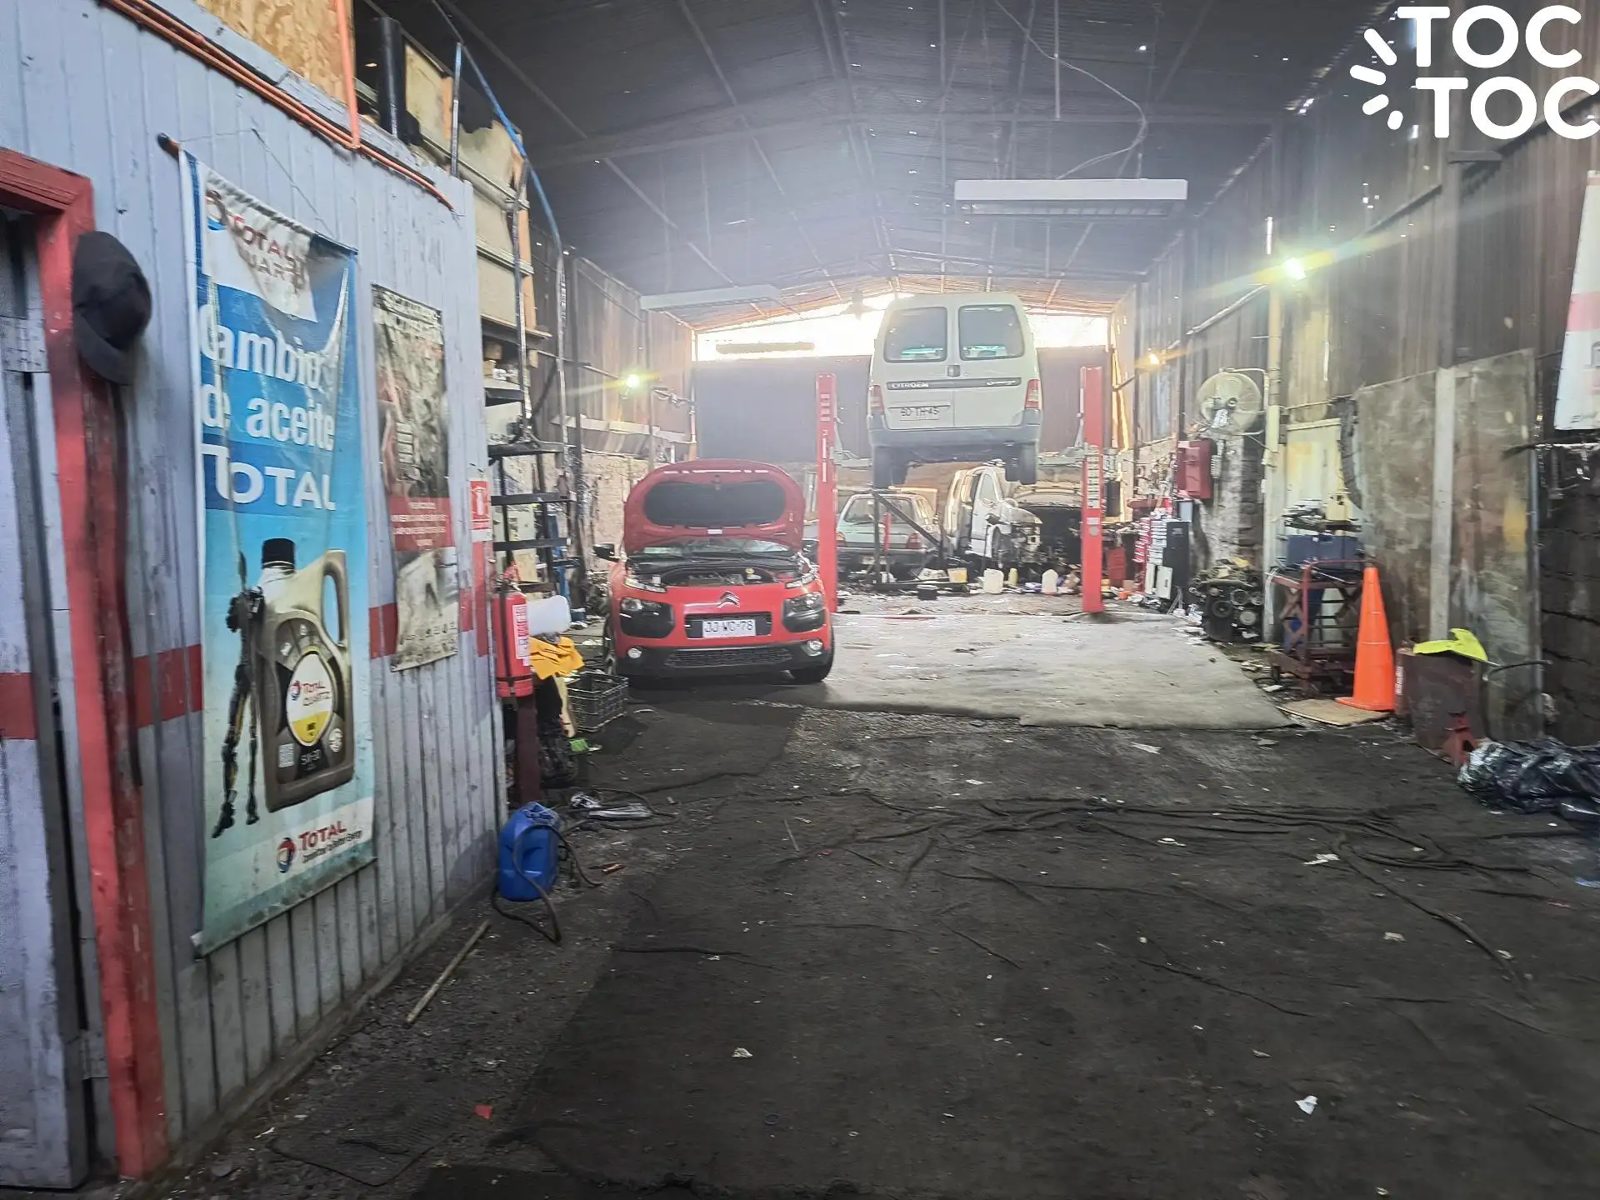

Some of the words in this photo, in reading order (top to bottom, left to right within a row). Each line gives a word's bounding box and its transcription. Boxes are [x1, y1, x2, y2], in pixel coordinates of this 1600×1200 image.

[246, 397, 336, 451] aceite
[200, 443, 336, 511] TOTAL
[298, 821, 347, 850] TOTAL
